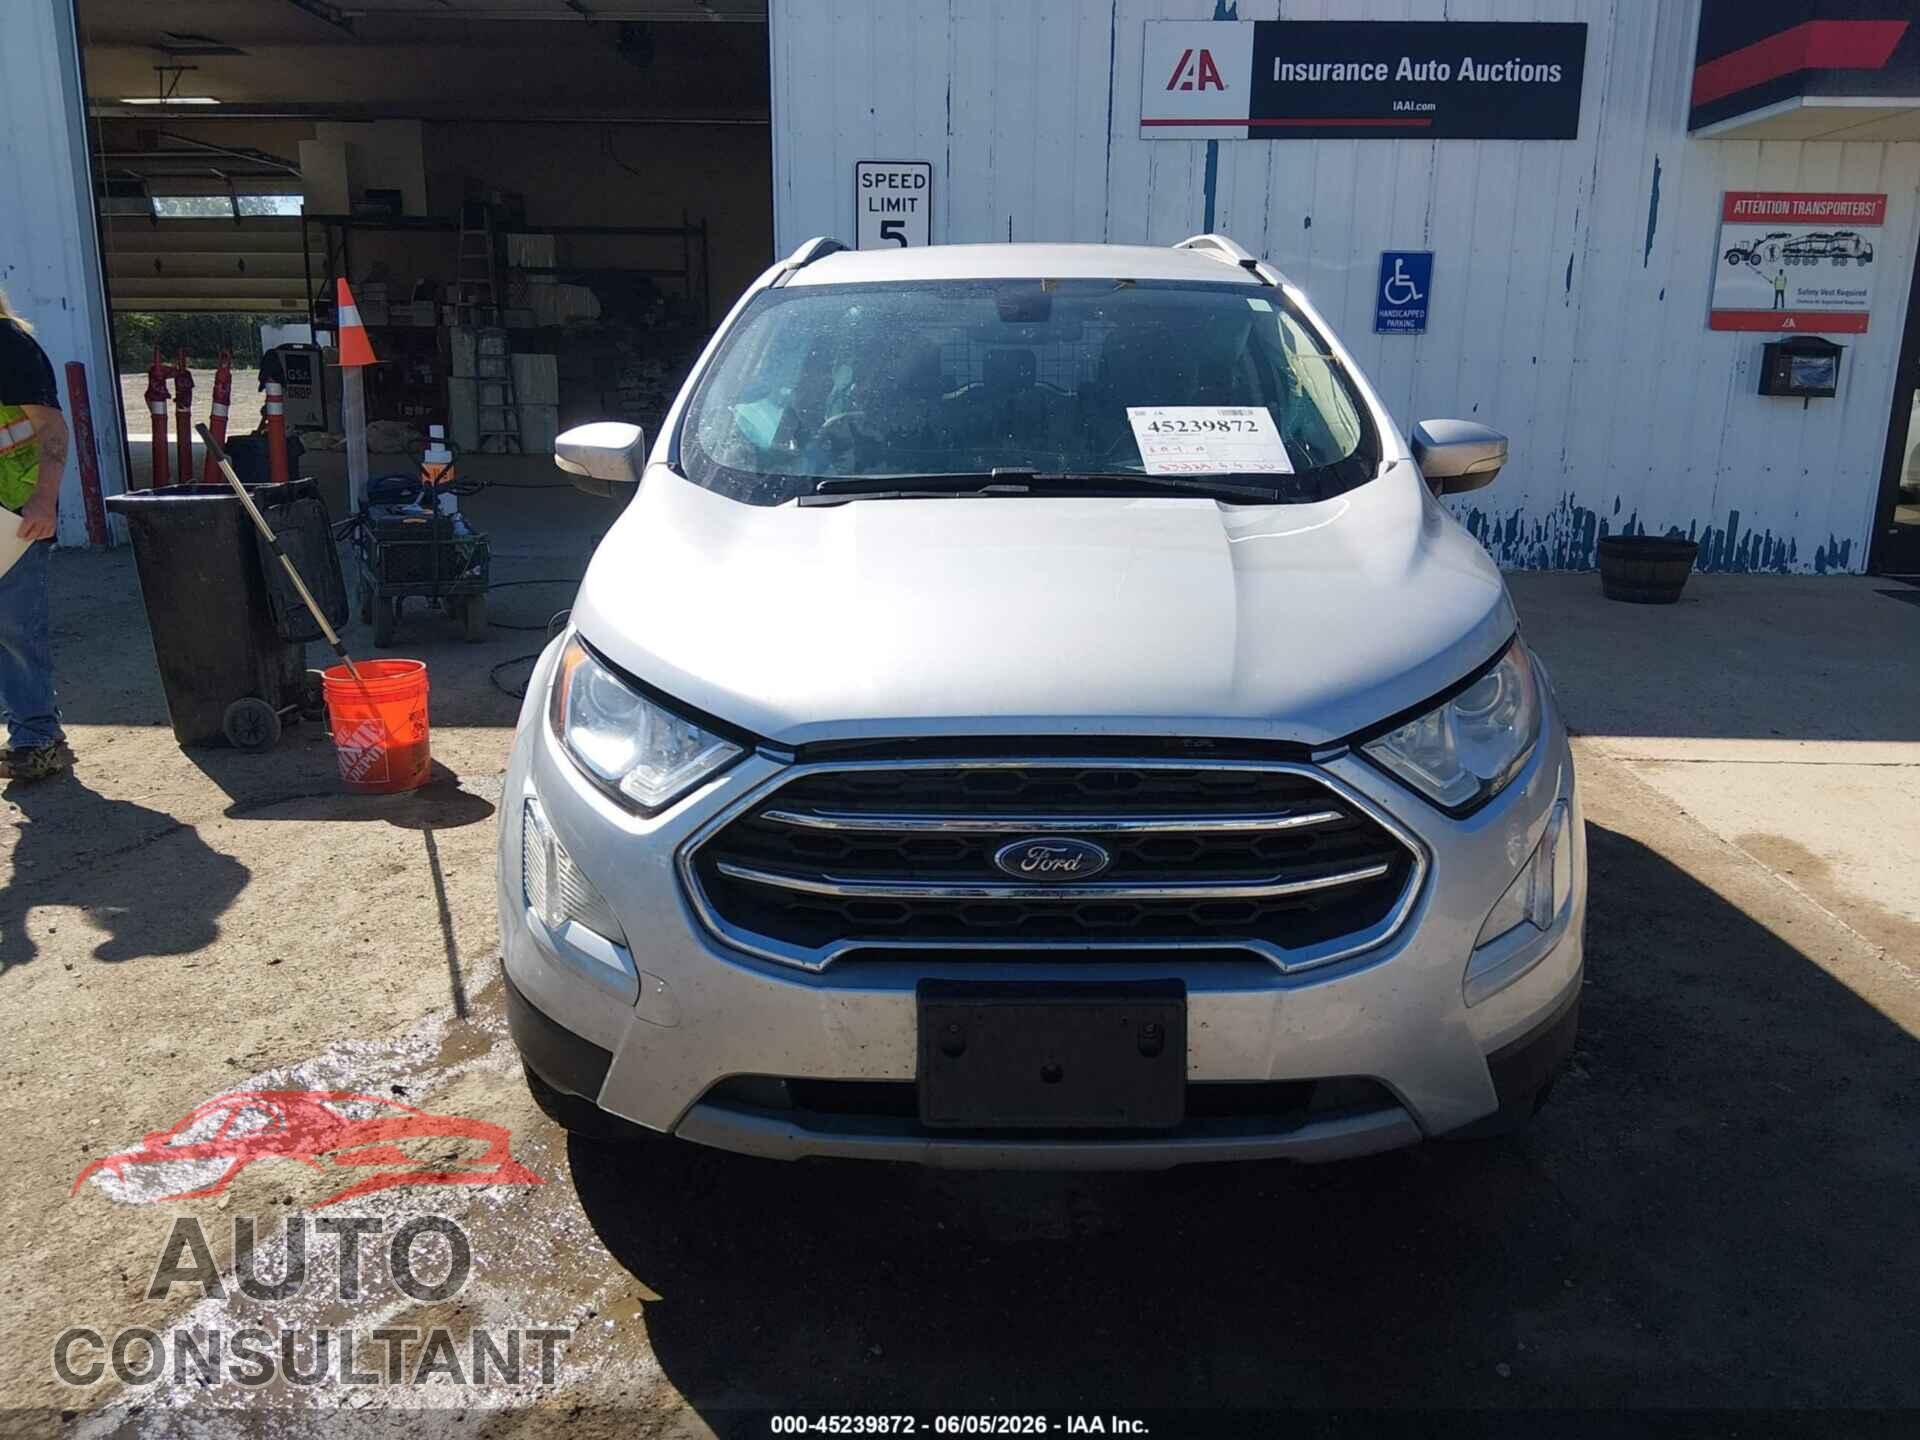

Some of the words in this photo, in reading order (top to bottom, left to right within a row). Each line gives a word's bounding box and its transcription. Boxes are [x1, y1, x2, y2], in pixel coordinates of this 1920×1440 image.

[1273, 56, 1389, 82] Insurance
[1395, 56, 1451, 82] Auto
[1457, 57, 1562, 83] Auctions
[1392, 101, 1437, 111] IAAI.com
[862, 172, 926, 189] SPEED
[869, 196, 918, 213] LIMIT
[1734, 199, 1790, 215] ATTENTION
[1792, 200, 1876, 217] TRANSPORTERS!
[880, 220, 908, 248] 5
[1836, 288, 1867, 298] Required
[1379, 309, 1425, 319] HANDICAPPED
[1386, 319, 1416, 328] PARKING
[1147, 420, 1259, 434] 45239872
[349, 745, 387, 783] DEPOT
[1021, 846, 1083, 871] Ford
